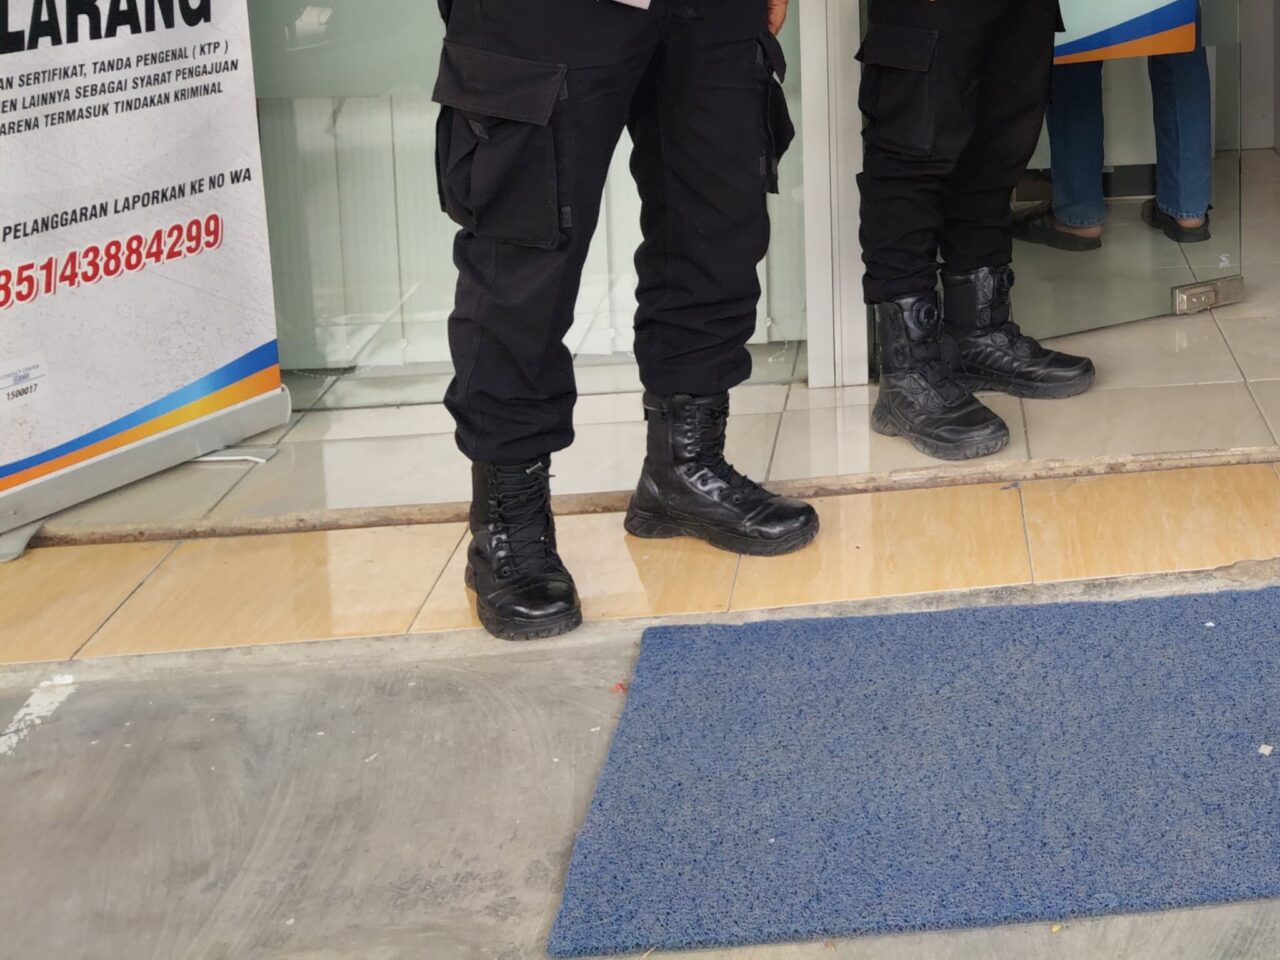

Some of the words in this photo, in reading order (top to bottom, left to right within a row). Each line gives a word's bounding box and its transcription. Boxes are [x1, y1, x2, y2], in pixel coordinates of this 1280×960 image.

[18, 63, 87, 87] SERTIFIKAT,
[92, 57, 132, 75] TANDA
[136, 46, 189, 68] PENGENAL
[200, 41, 220, 56] KTP
[22, 88, 71, 110] LAINNYA
[75, 78, 128, 99] SEBAGAI
[132, 70, 172, 90] SYARAT
[175, 59, 239, 82] PENGAJUAN
[44, 102, 110, 128] TERMASUK
[114, 91, 171, 114] TINDAKAN
[174, 81, 223, 102] KRIMINAL
[3, 201, 108, 242] PELANGGARAN
[114, 183, 186, 214] LAPORKAN
[190, 178, 205, 196] KE
[208, 173, 225, 190] NO
[230, 168, 252, 184] WA
